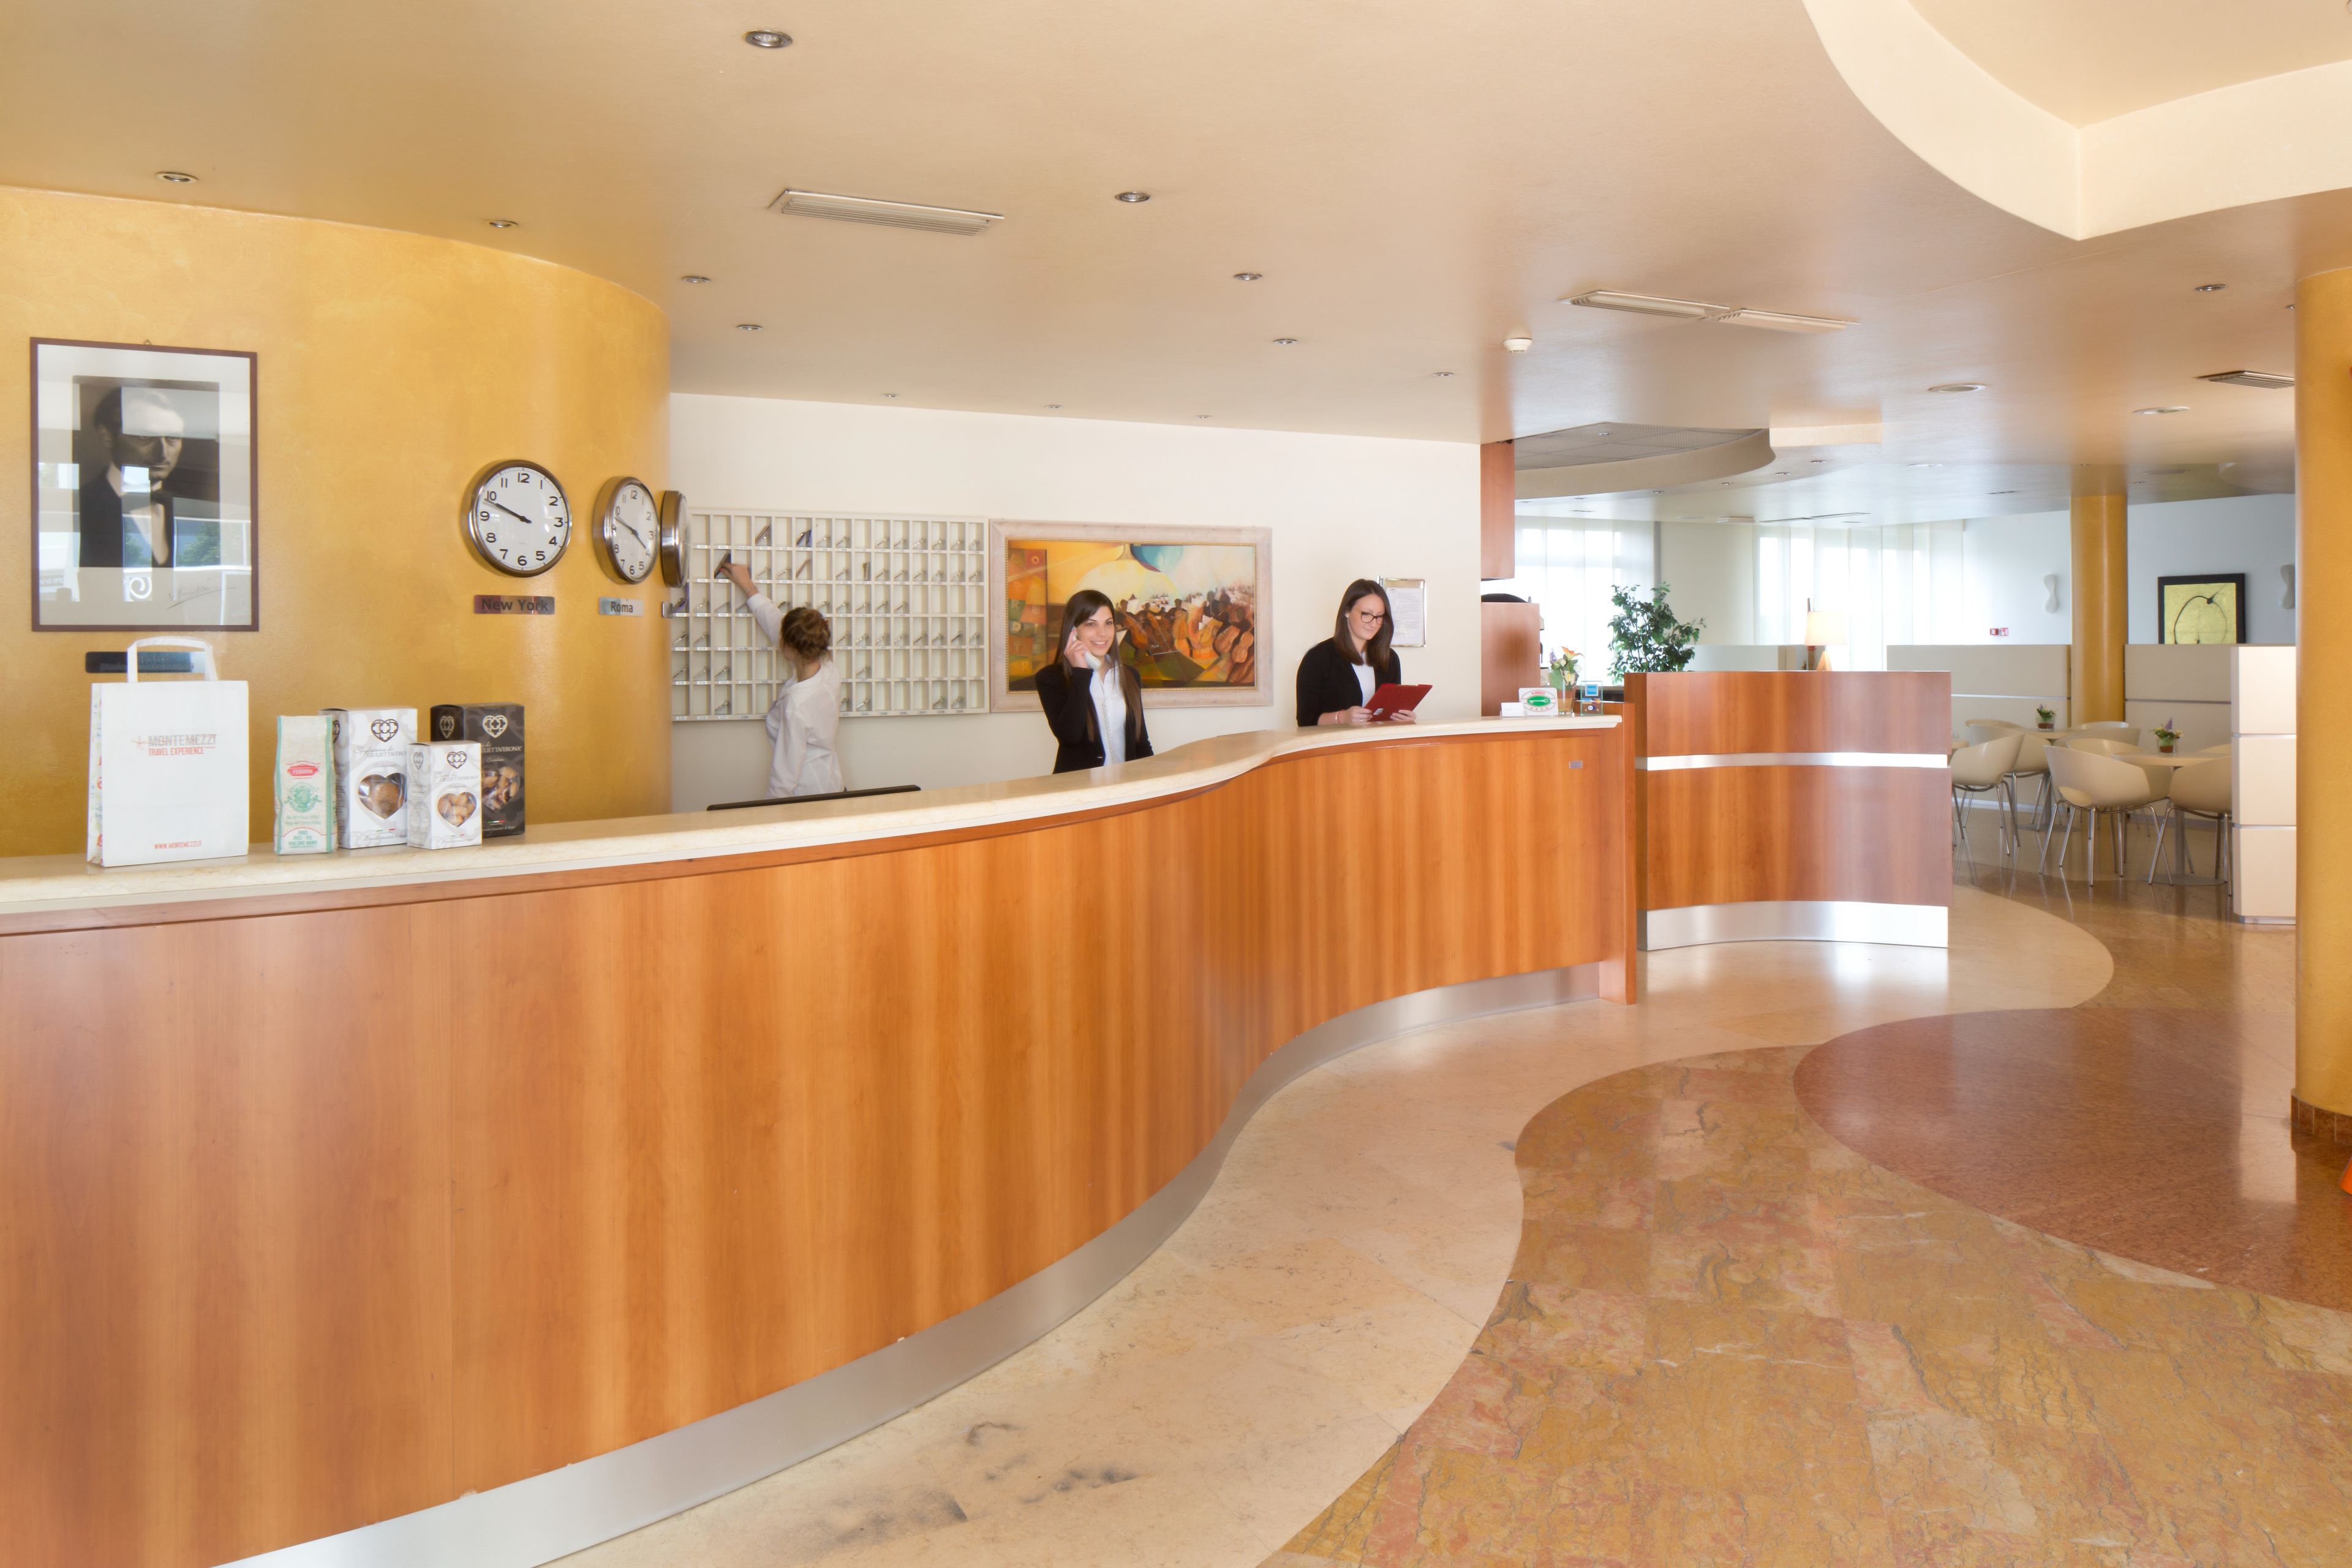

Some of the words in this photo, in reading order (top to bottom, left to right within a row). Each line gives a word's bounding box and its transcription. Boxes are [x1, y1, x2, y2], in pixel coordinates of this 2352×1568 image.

[500, 478, 508, 488] 11
[518, 472, 530, 484] 12
[540, 480, 543, 489] 1
[486, 491, 497, 501] 10
[622, 494, 627, 503] 11
[631, 490, 638, 499] 12
[549, 496, 558, 506] 2
[480, 511, 489, 521] 9
[646, 512, 652, 521] 2
[554, 517, 563, 527] 3
[486, 533, 496, 543] 8
[649, 531, 654, 540] 3
[549, 536, 557, 546] 4
[614, 544, 619, 553] 8
[500, 549, 508, 560] 7
[535, 551, 545, 560] 5
[518, 556, 527, 565] 6
[620, 560, 625, 568] 7
[630, 565, 635, 575] 6
[639, 562, 644, 570] 5
[481, 598, 513, 611] New
[518, 599, 549, 611] York
[611, 601, 633, 613] Roma
[148, 734, 216, 747] MONTEMEZZI
[148, 748, 168, 756] TRAVEL
[170, 746, 205, 755] EXPERIENCE
